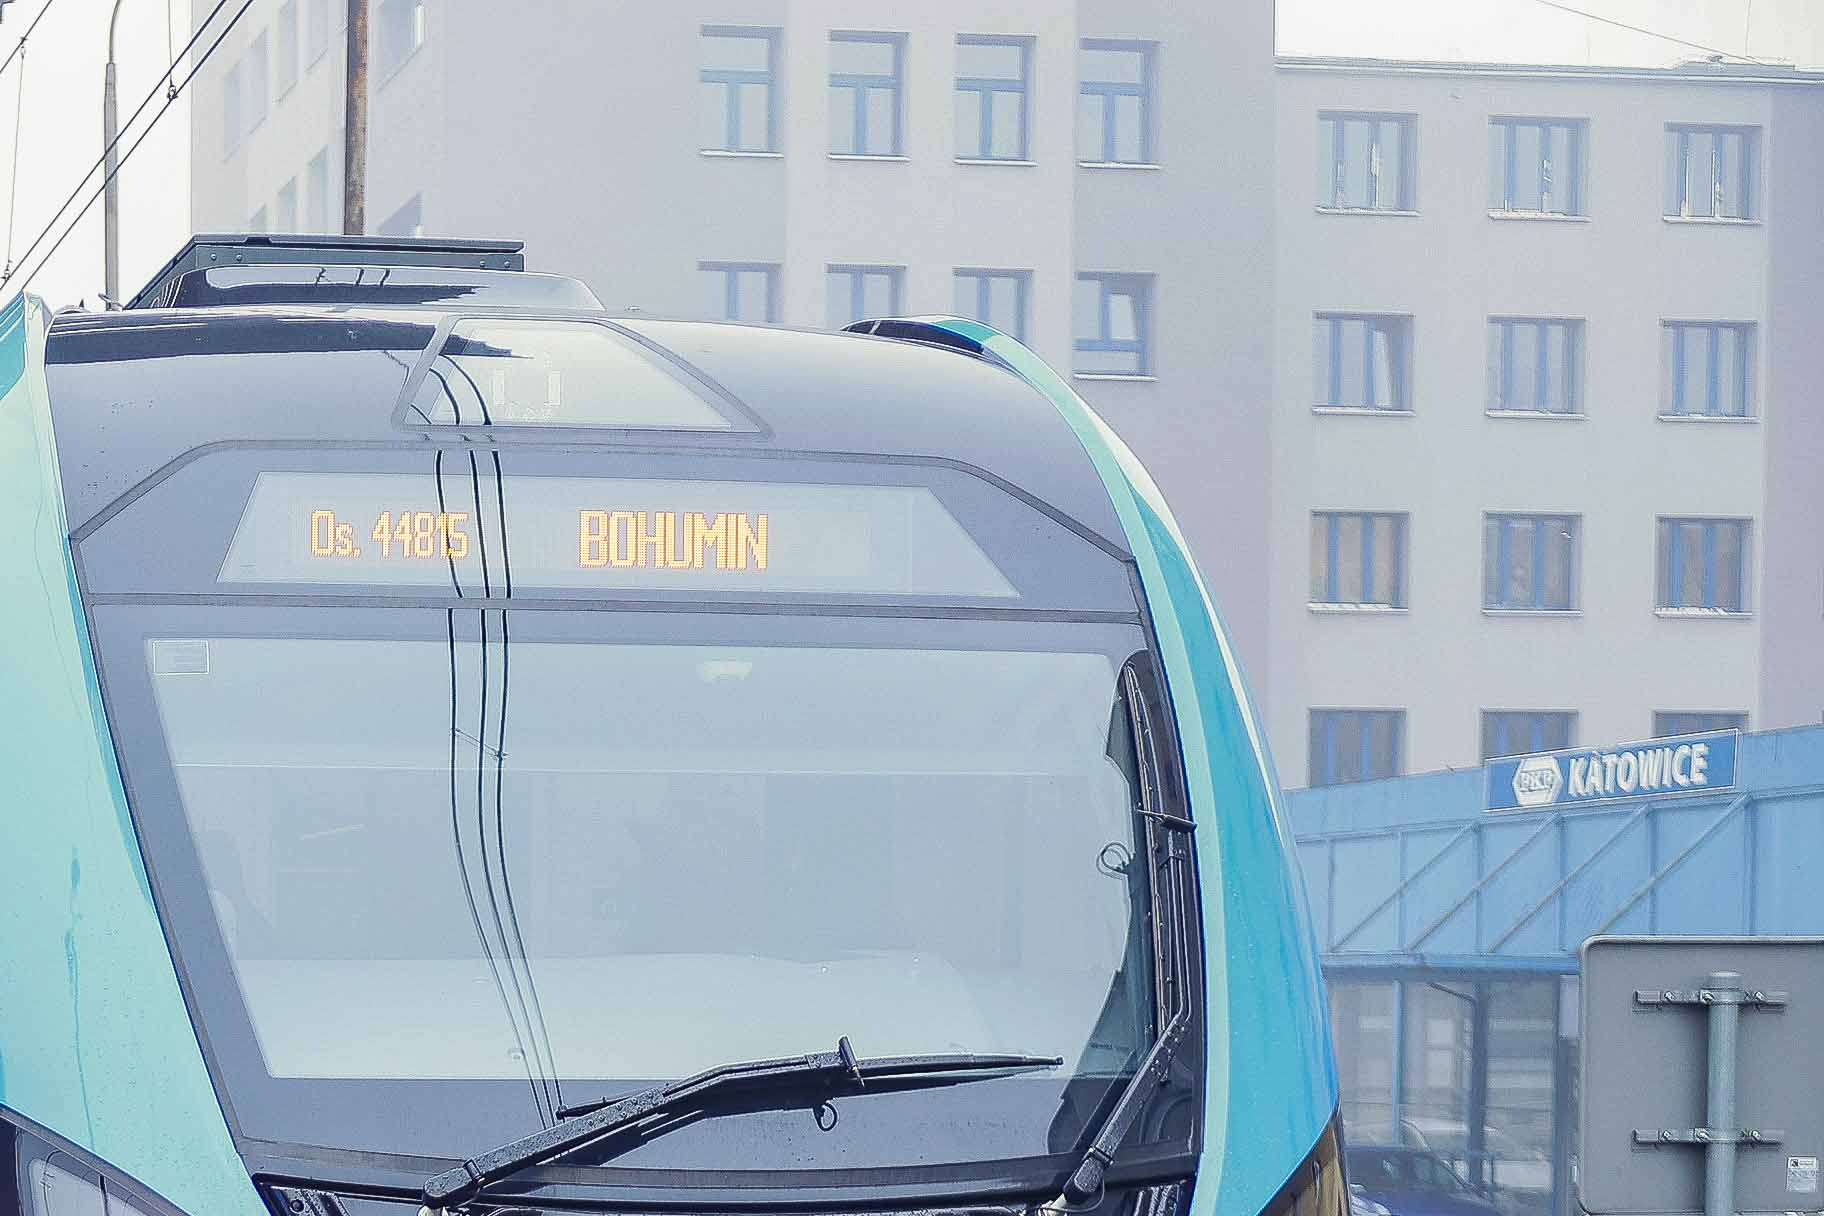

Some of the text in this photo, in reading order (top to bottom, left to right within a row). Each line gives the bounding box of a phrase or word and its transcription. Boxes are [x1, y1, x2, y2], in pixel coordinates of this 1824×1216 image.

[311, 509, 769, 569] Os. 44815 BOHUMIN
[1568, 743, 1710, 797] KATOWICE
